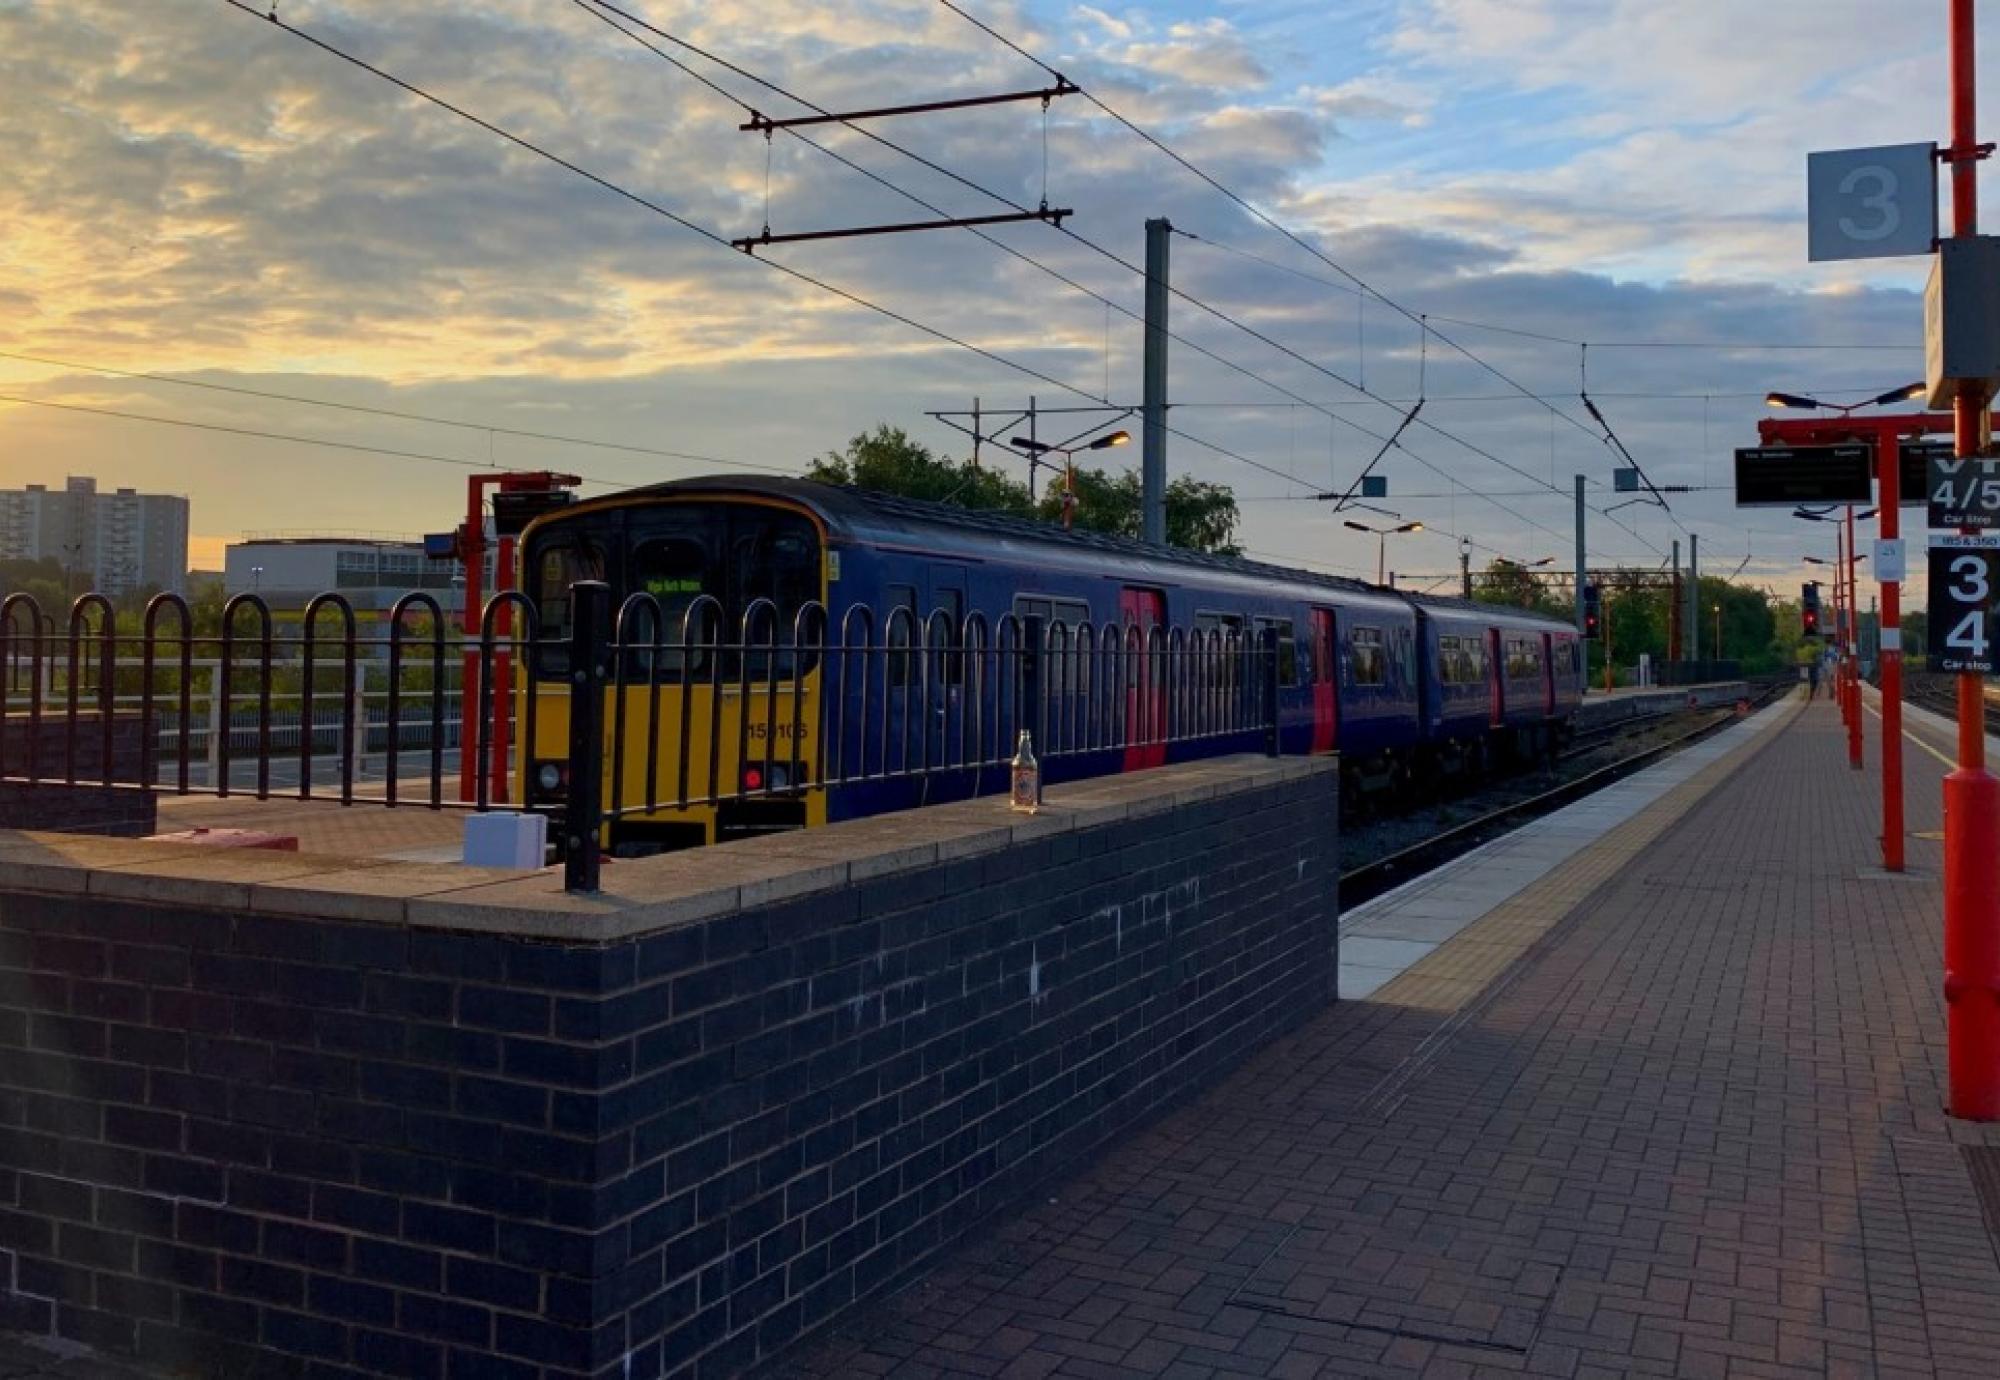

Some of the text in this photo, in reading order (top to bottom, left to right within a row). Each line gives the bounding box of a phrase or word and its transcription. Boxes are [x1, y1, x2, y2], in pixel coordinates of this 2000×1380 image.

[1838, 164, 1899, 241] 3
[1931, 476, 2000, 510] 4/5
[1943, 513, 1963, 523] Car
[1948, 554, 1989, 602] 3
[1946, 610, 1990, 656] 4
[1943, 658, 1963, 670] Car
